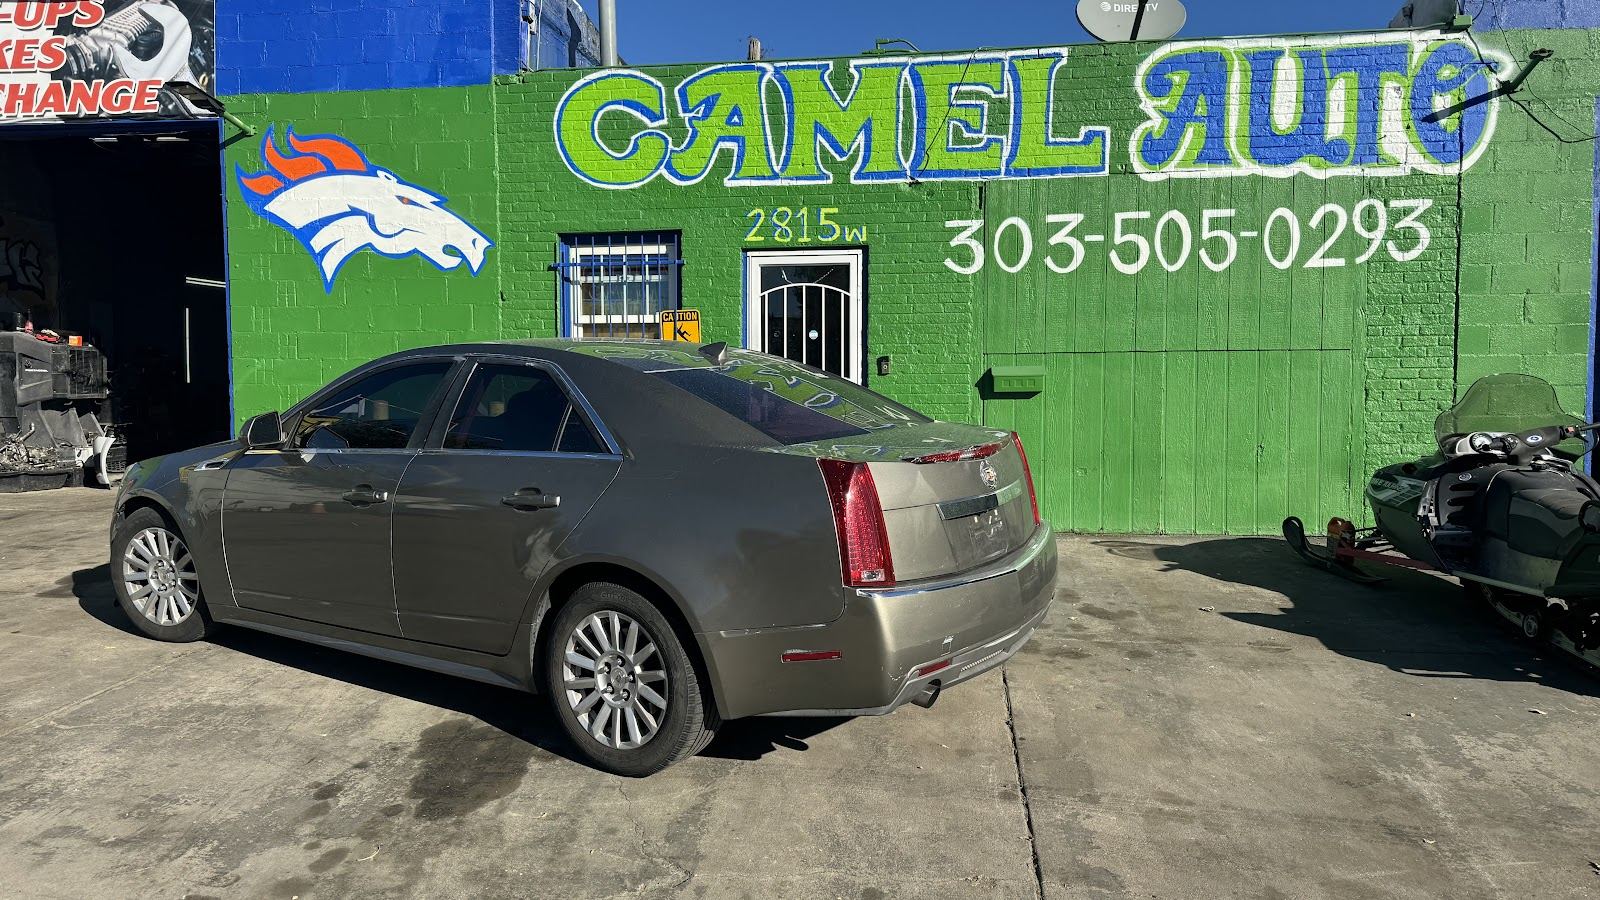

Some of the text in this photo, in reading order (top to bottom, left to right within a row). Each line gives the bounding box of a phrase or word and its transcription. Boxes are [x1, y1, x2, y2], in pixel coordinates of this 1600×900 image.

[1113, 3, 1159, 13] DIRETV
[0, 80, 161, 114] HANGE
[554, 33, 1511, 189] CAMEL AUTO
[943, 198, 1433, 275] 303-505-0293
